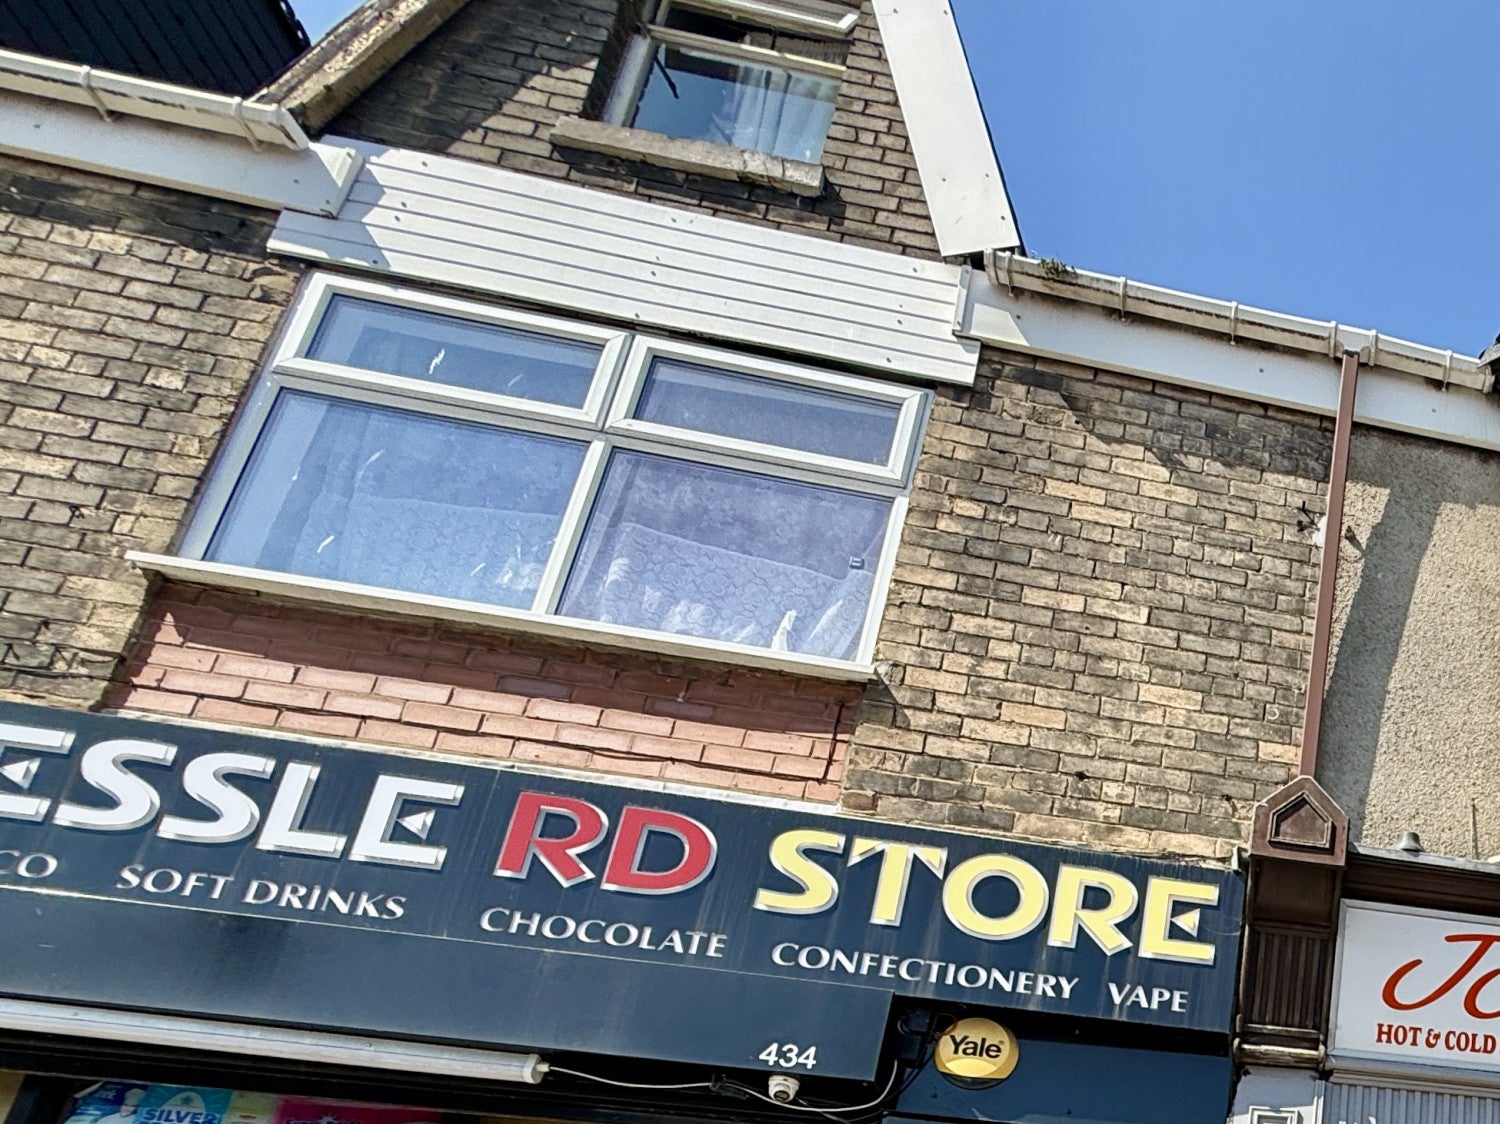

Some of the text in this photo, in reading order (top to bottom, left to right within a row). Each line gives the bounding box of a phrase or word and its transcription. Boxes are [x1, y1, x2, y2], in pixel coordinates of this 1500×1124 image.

[115, 864, 407, 920] SOFT DRINKS
[493, 791, 717, 894] RD
[753, 829, 1219, 965] STORE
[479, 907, 728, 958] CHOCOLATE
[772, 942, 1079, 999] CONFECTIONERY
[1108, 983, 1188, 1012] VAPE
[758, 1042, 817, 1070] 434
[949, 1035, 1002, 1059] Yale
[1376, 1023, 1422, 1047] HOT
[1425, 1028, 1441, 1049] &
[1444, 1030, 1496, 1055] COLD
